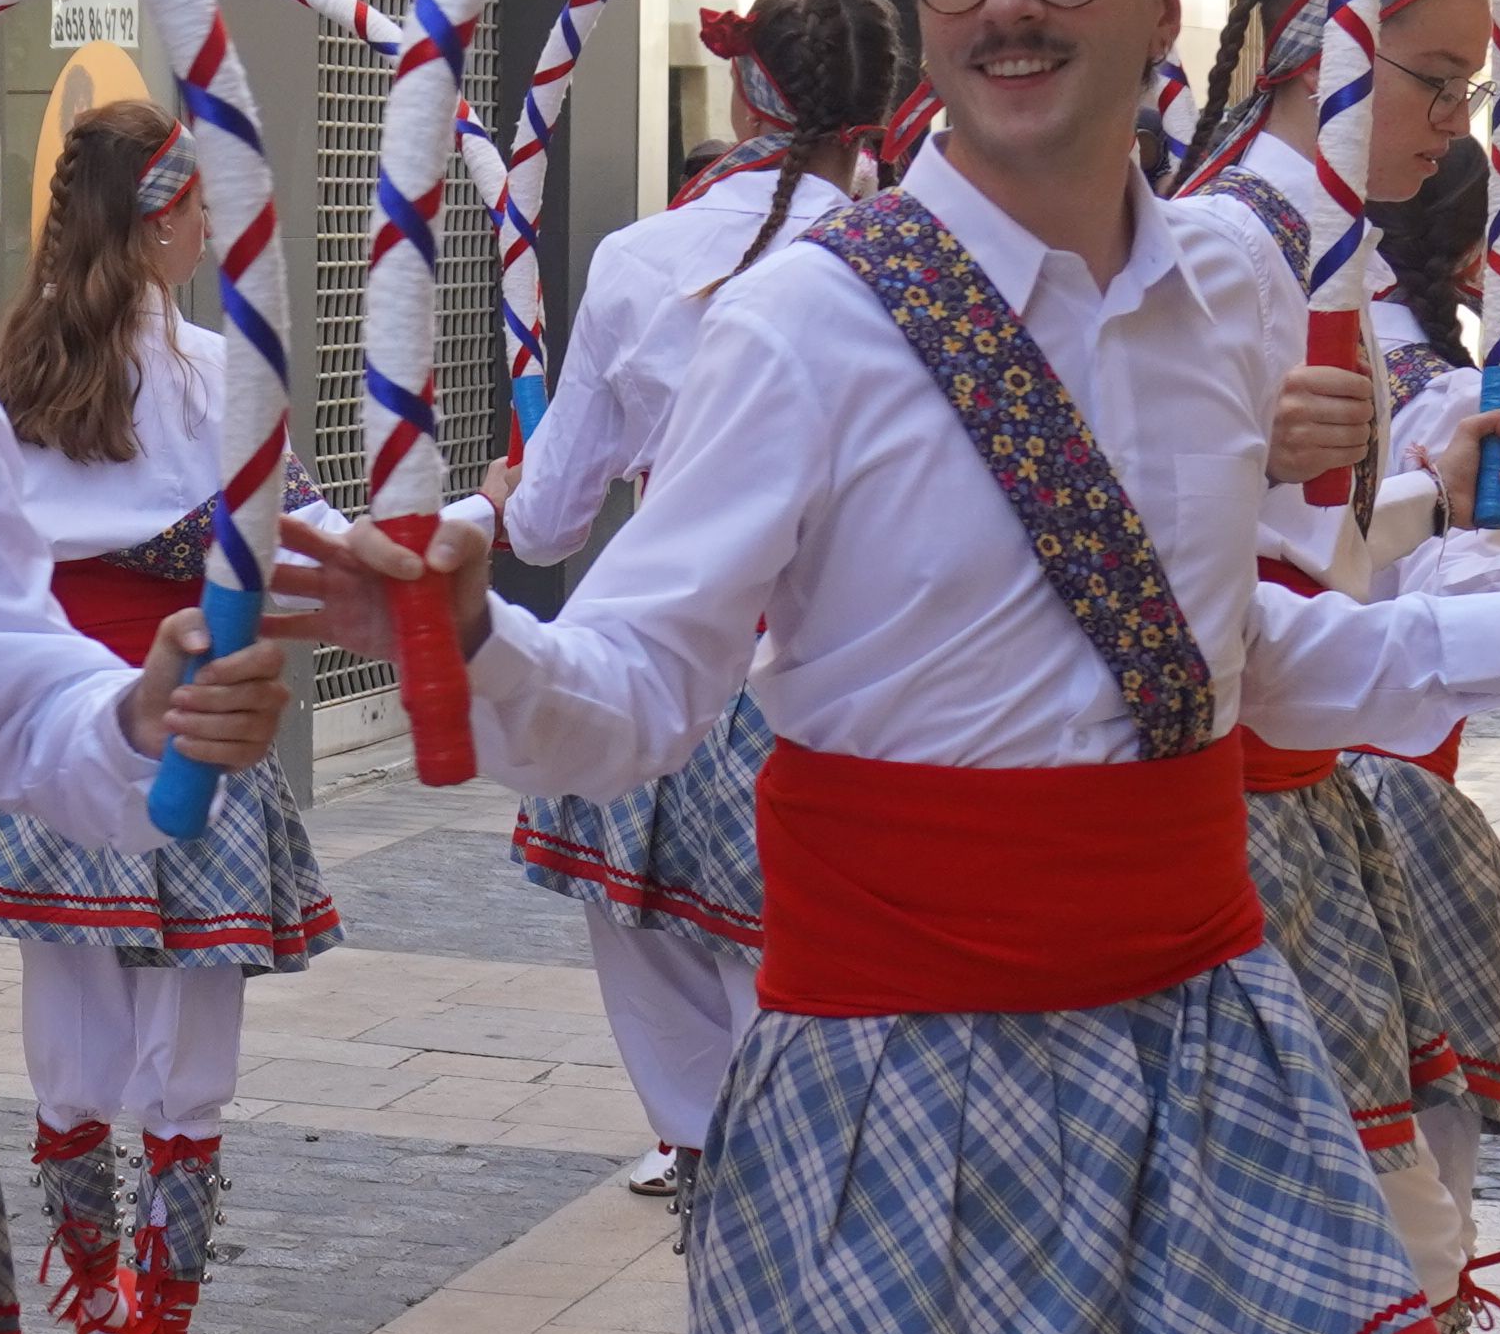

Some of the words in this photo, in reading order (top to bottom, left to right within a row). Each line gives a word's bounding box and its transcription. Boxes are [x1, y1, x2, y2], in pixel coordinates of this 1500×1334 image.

[65, 6, 86, 41] 658
[88, 6, 103, 41] 86
[119, 7, 134, 41] 92
